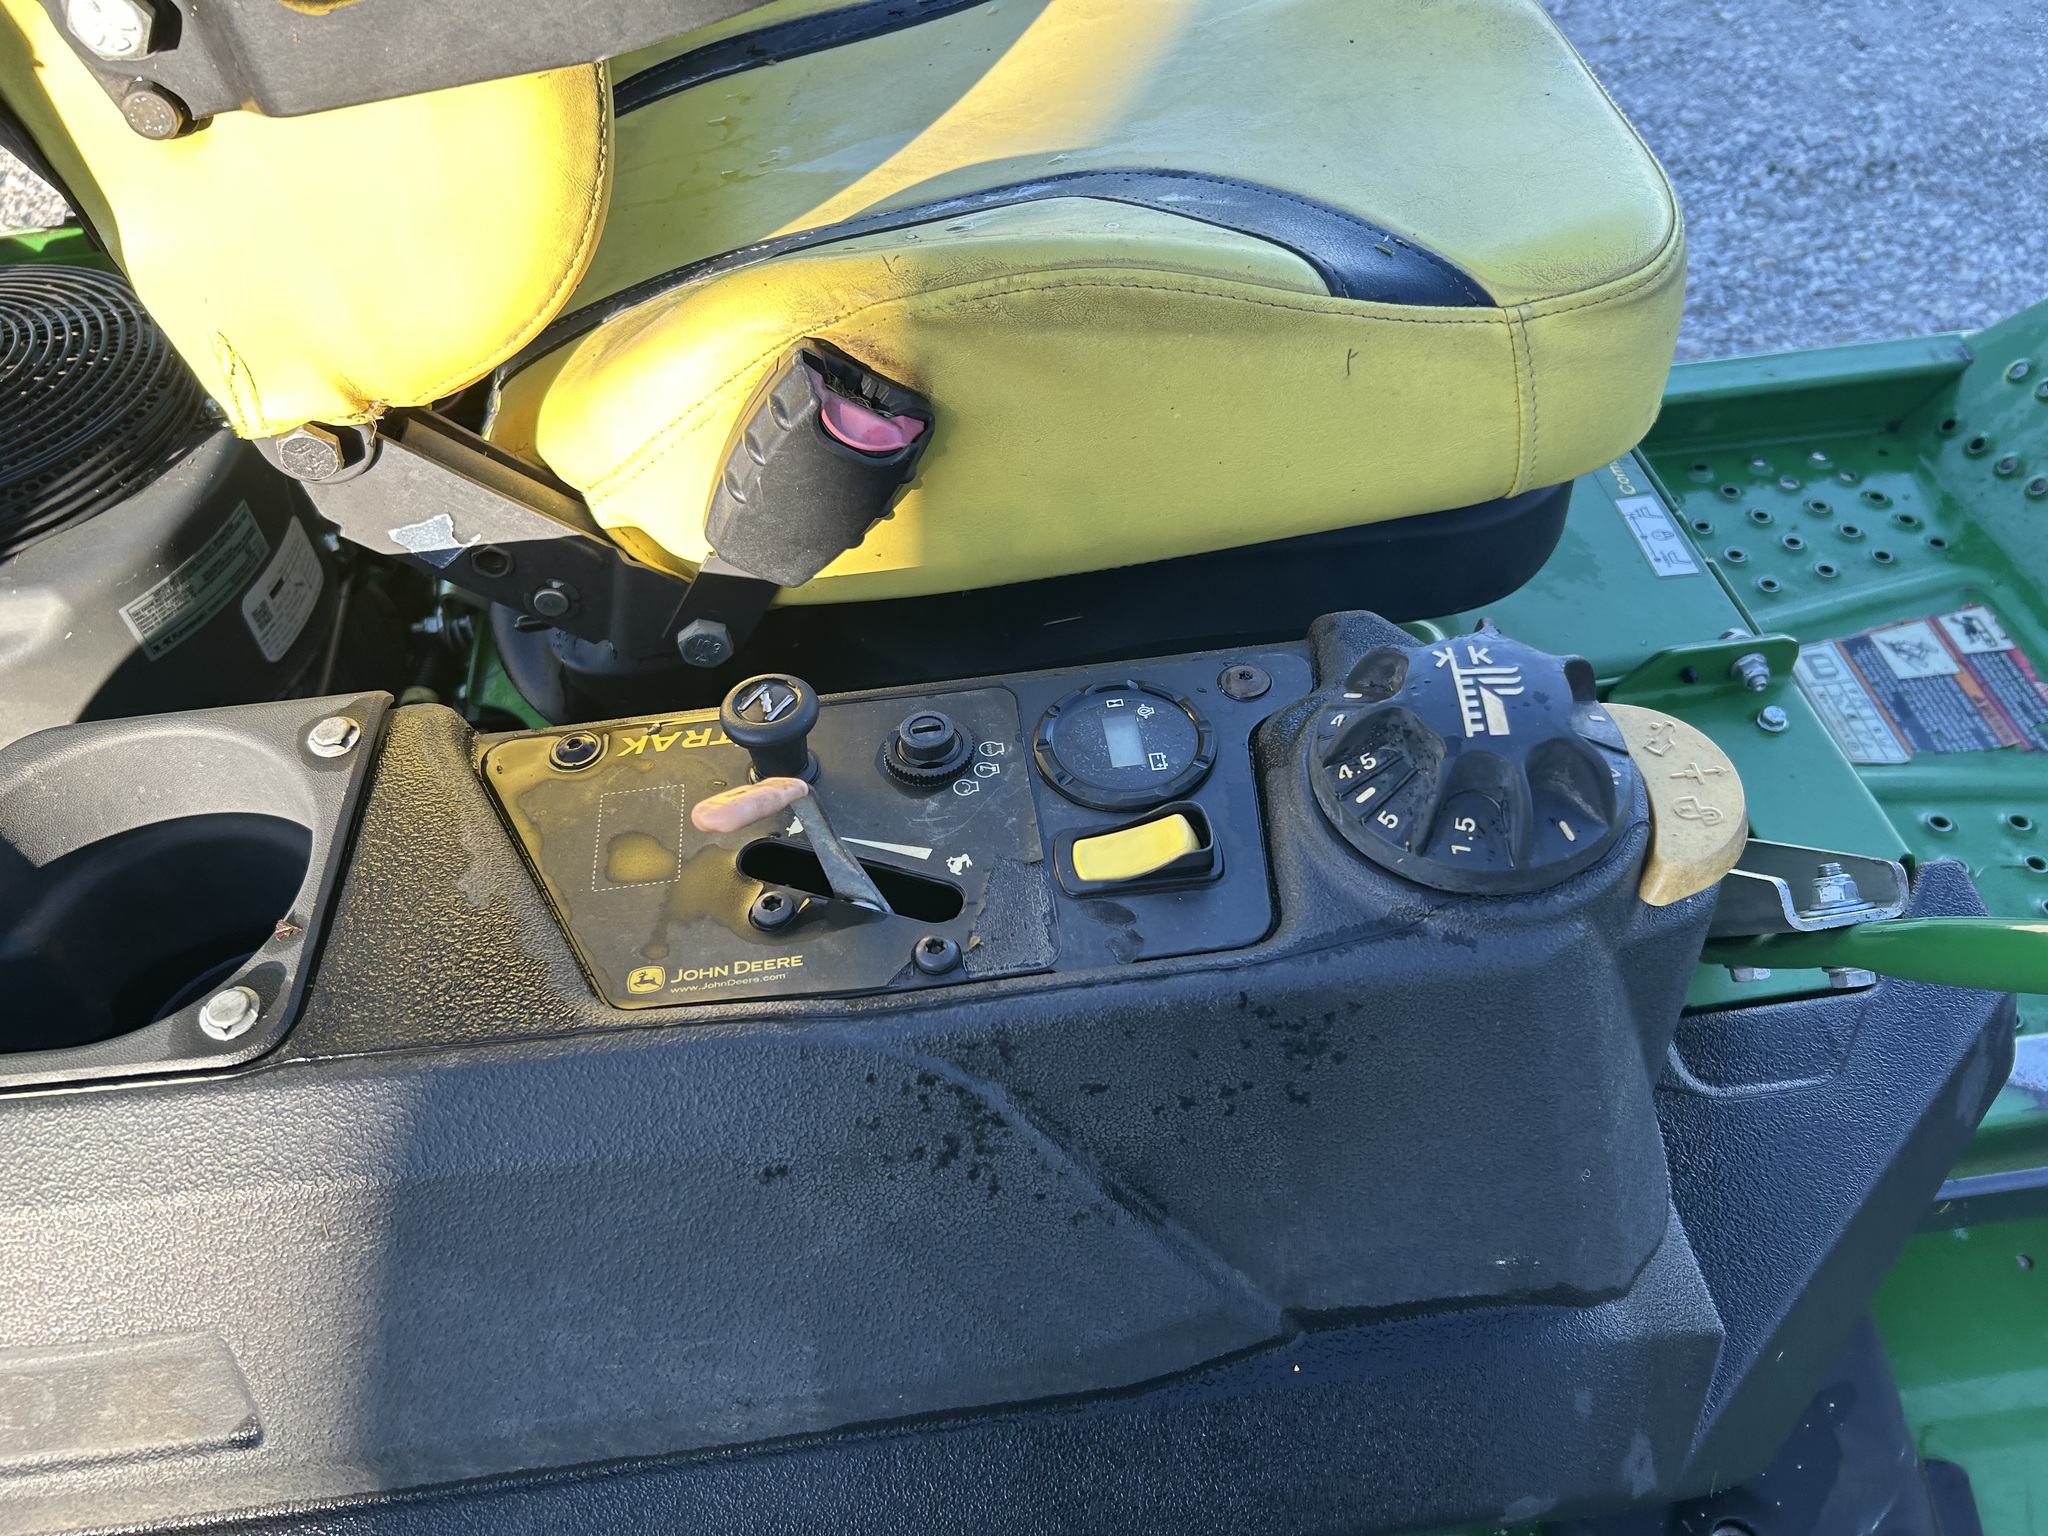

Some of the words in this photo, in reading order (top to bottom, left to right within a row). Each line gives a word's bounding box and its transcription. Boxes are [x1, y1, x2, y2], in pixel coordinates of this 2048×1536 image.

[617, 727, 739, 757] TRAK
[1337, 752, 1378, 781] 4.5
[1376, 810, 1399, 830] 5
[1450, 816, 1476, 855] 1.5
[670, 964, 730, 984] JOHN
[733, 954, 804, 976] DEERE
[670, 973, 787, 994] www.JohnDeere.com
